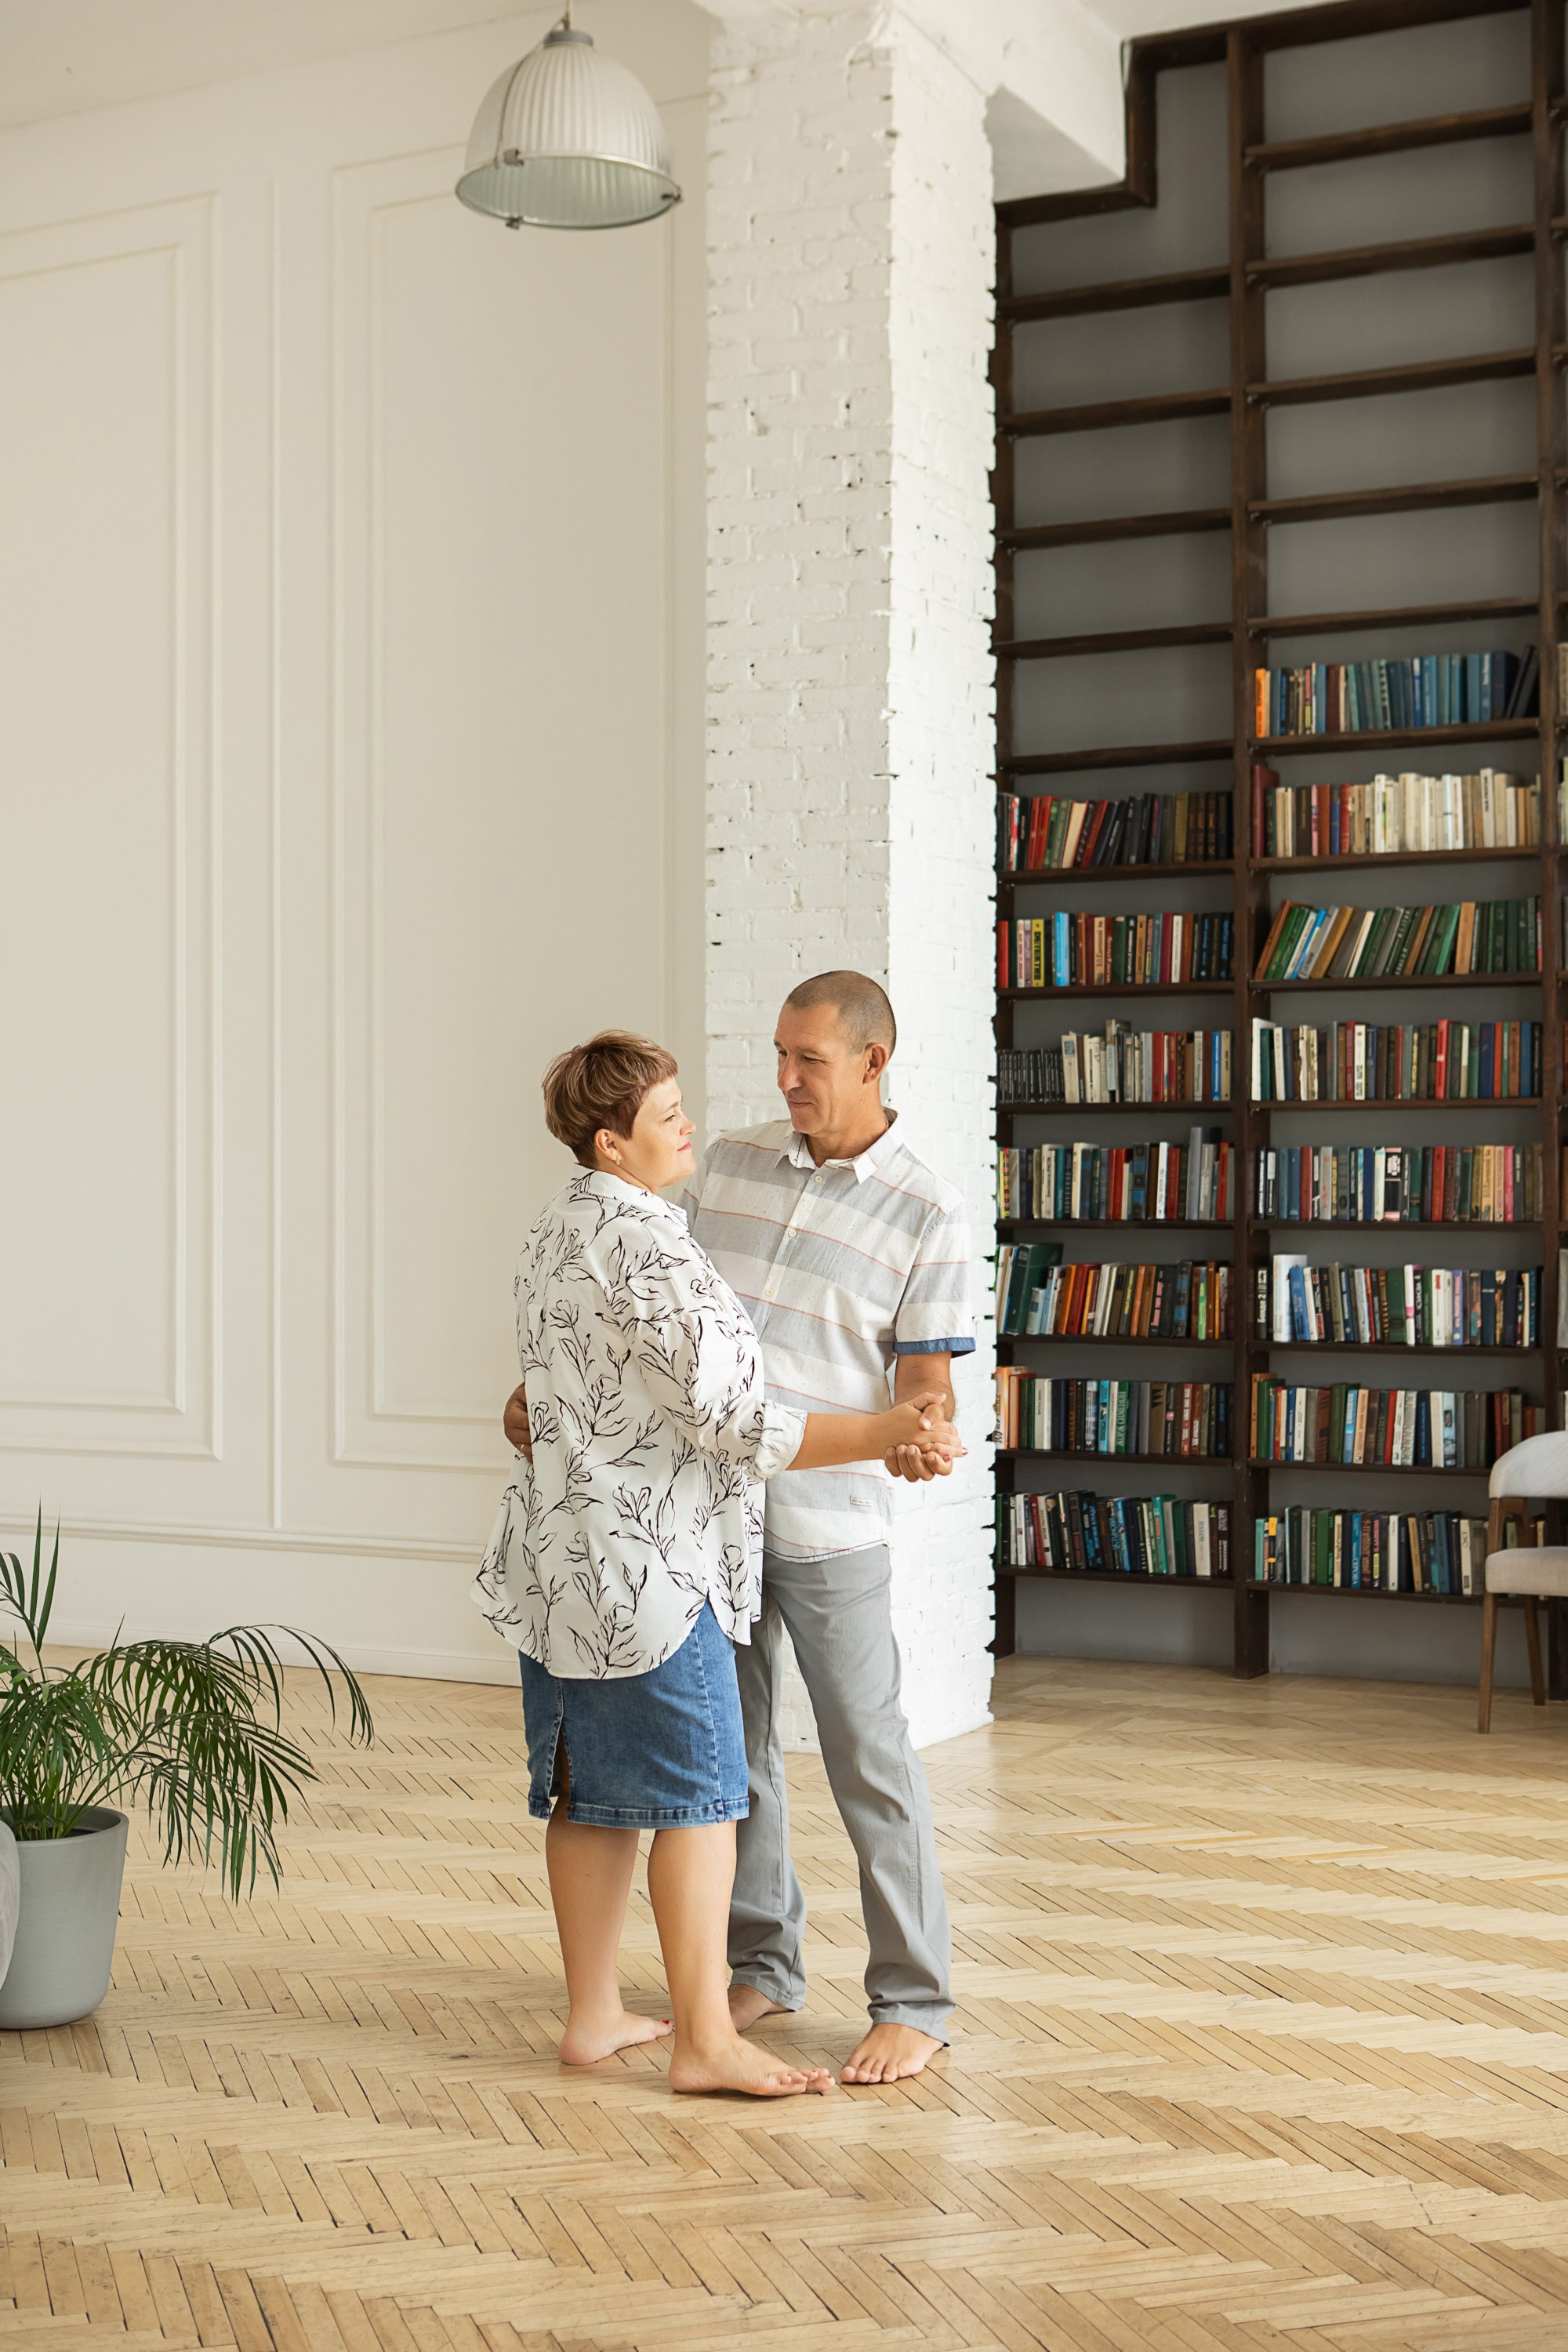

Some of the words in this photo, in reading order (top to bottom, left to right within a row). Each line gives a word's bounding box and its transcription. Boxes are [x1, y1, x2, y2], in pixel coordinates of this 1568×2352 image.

[1258, 1300, 1266, 1323] Банда
[1116, 1392, 1127, 1426] СИМЕНОН
[1116, 1426, 1125, 1447] ЖОРЖ
[1209, 1507, 1216, 1519] 1
[1109, 1517, 1119, 1550] УСТИНОВА
